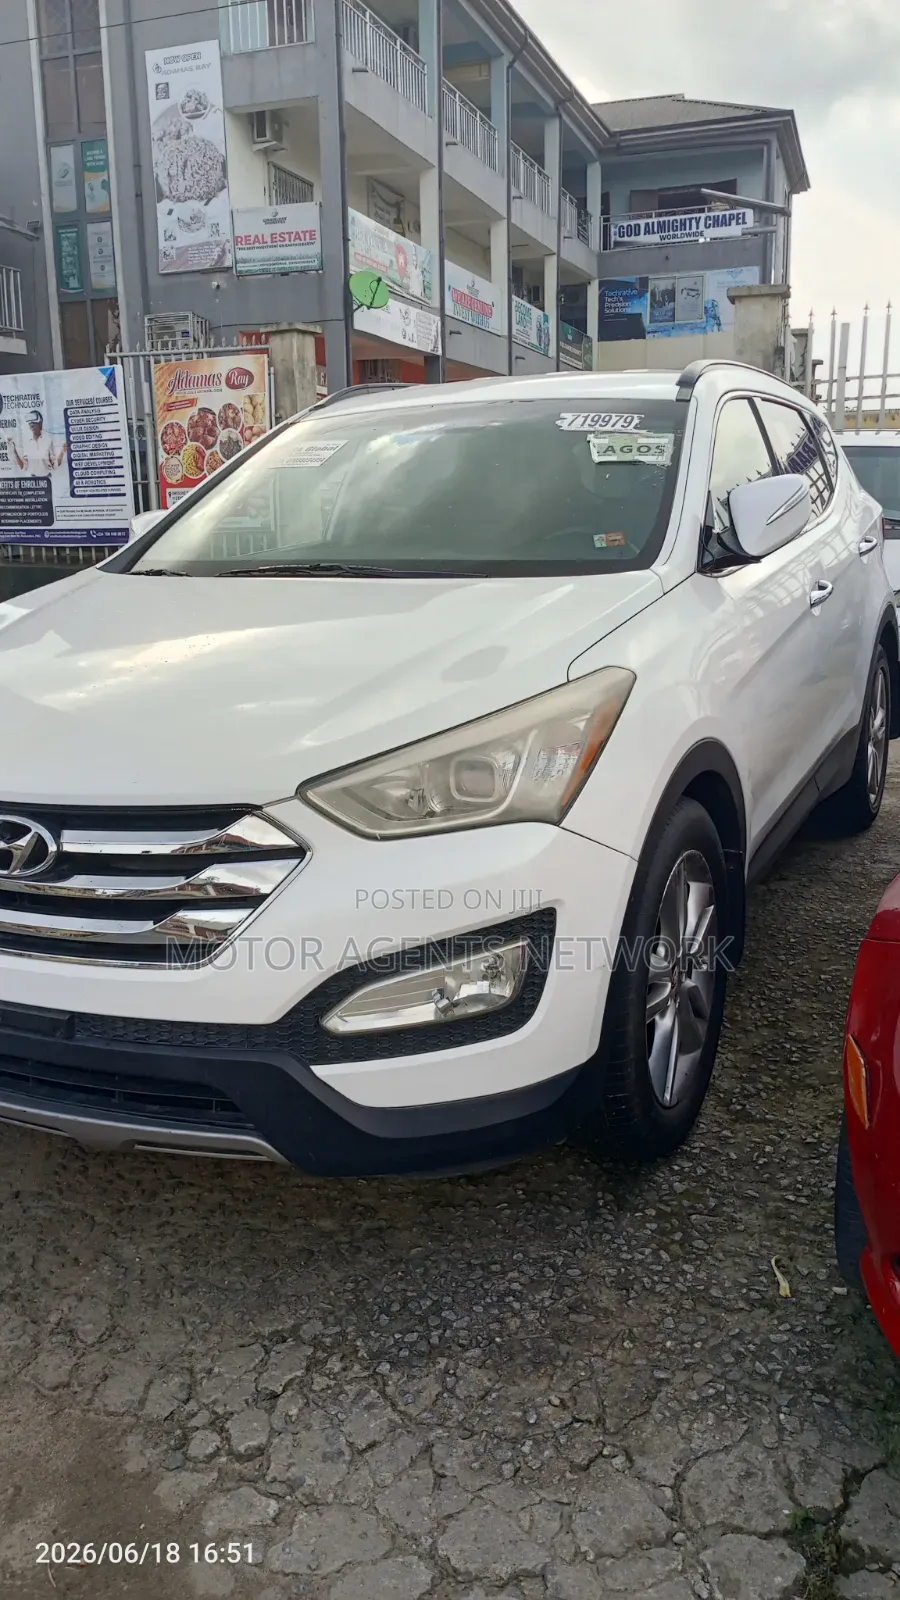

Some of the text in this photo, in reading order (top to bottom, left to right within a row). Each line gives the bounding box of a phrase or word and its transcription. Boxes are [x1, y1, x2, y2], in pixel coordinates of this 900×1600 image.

[164, 52, 201, 65] NOW OPEN
[196, 62, 212, 70] RAY
[618, 212, 747, 238] GOD ALMIGHTY CHAPEL
[235, 230, 317, 246] REAL ESTATE
[659, 231, 704, 241] WORLDWIDE
[168, 368, 249, 396] Adamas Ray
[3, 393, 40, 402] TECHRATIVE
[4, 400, 44, 409] TECHNOLOGY
[597, 445, 666, 454] AGOS
